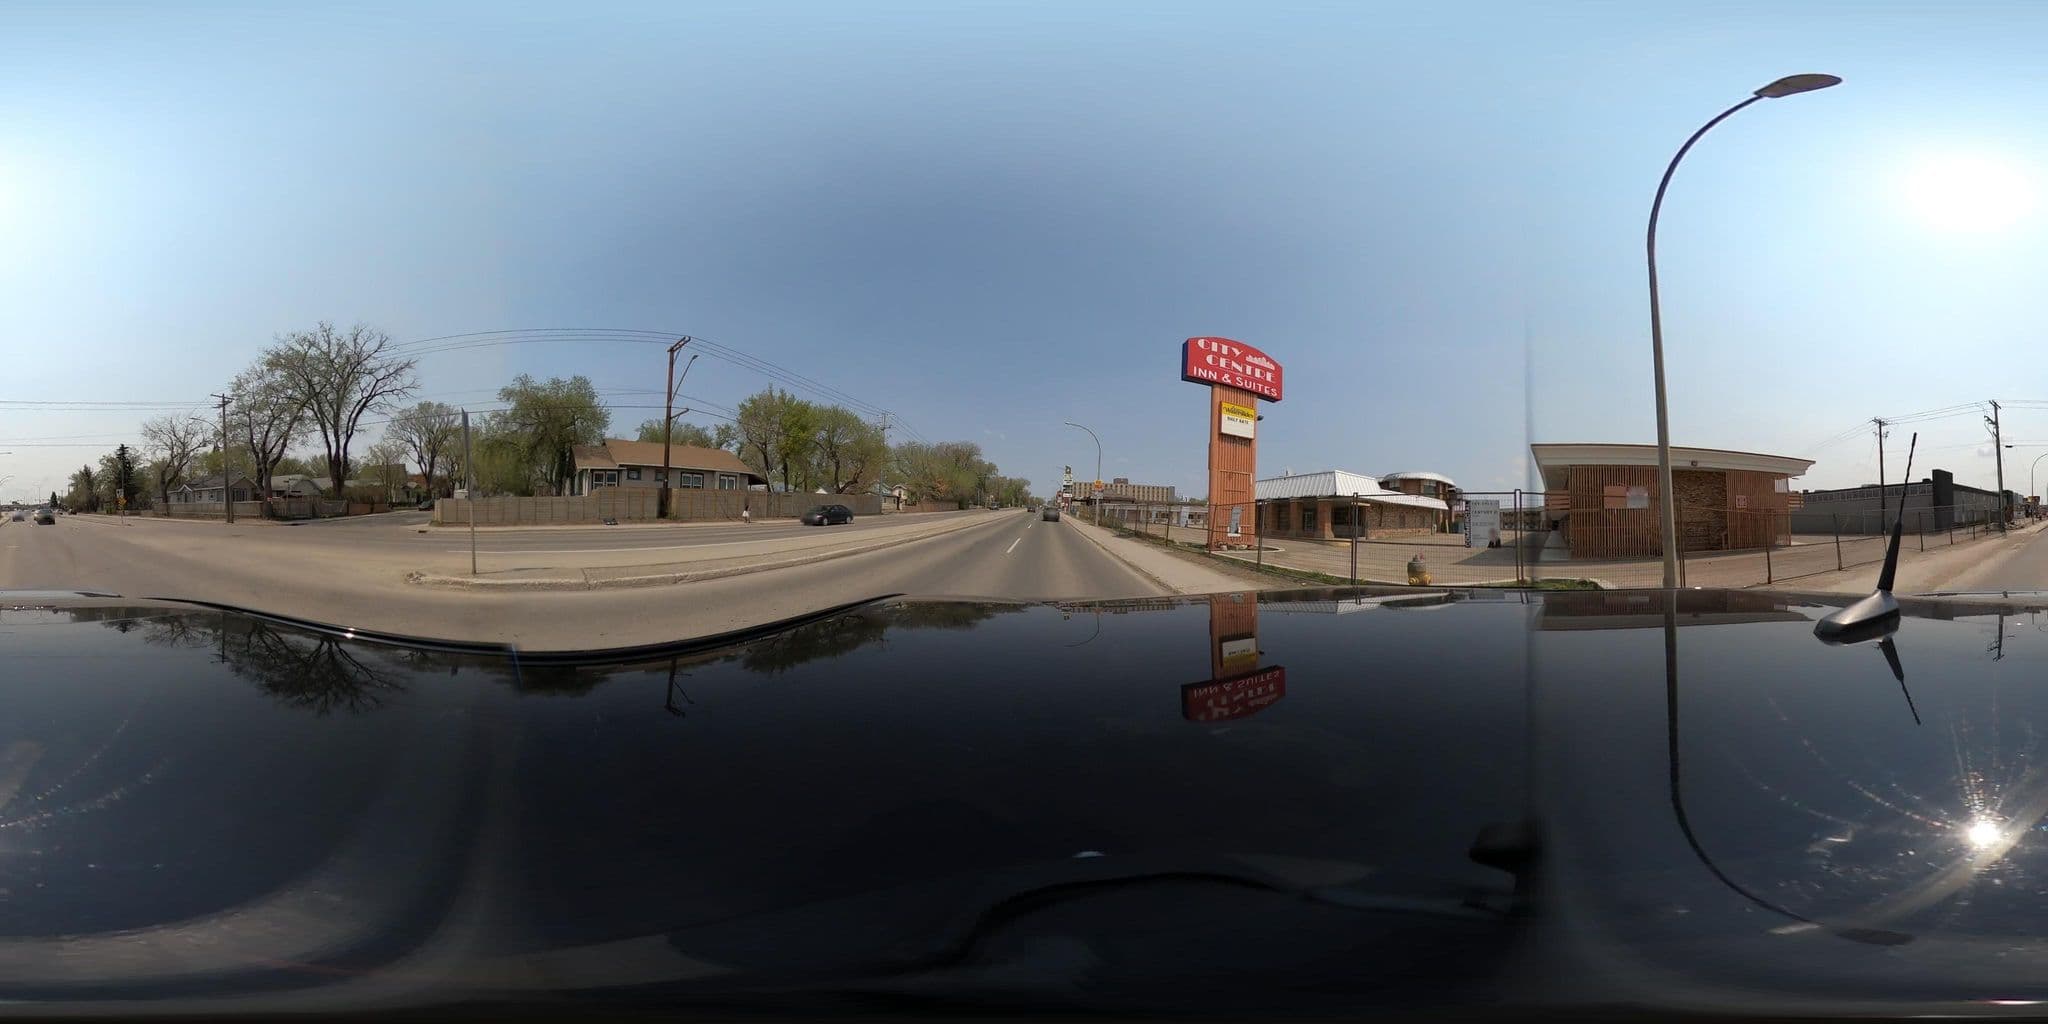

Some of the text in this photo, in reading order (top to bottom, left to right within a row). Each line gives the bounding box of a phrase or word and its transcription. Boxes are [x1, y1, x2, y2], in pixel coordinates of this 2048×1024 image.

[1197, 338, 1243, 357] CITY
[1193, 366, 1278, 397] INN & SUITES
[1206, 354, 1276, 384] CENTRE
